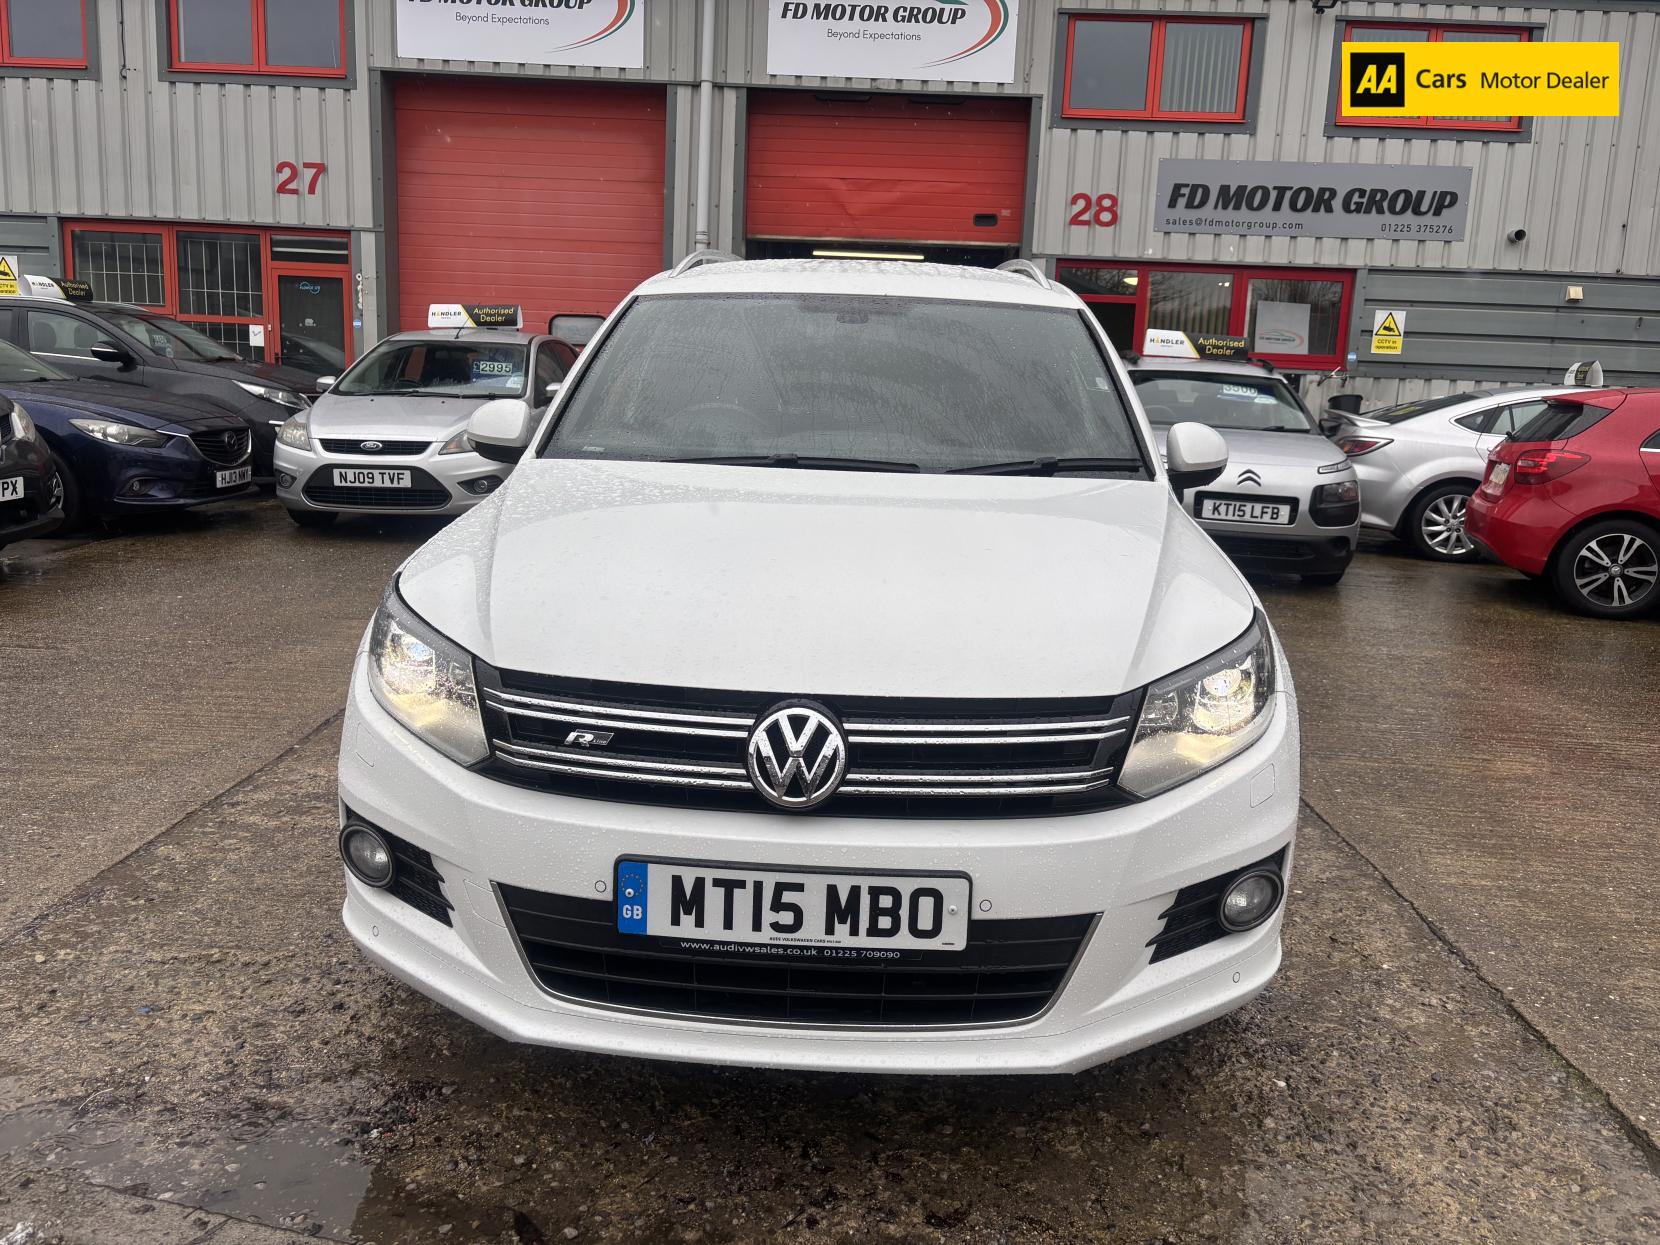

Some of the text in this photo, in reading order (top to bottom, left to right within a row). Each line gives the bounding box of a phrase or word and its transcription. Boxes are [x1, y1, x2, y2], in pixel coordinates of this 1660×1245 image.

[455, 12, 550, 26] Beyond Expectations
[781, 2, 966, 25] FD MOTOR GROUP
[827, 28, 922, 42] Beyond Expectations
[275, 161, 326, 195] 27
[1167, 183, 1459, 217] FD MOTOR GROUP
[1069, 192, 1119, 228] 28
[1165, 217, 1303, 231] sales@fdmotorgroup.com
[1380, 223, 1454, 235] 01225 375276
[473, 307, 514, 315] Authorised
[480, 314, 506, 322] Dealer
[1198, 337, 1245, 348] Authorised
[1205, 346, 1236, 356] Dealer
[339, 471, 405, 485] NJ09 TVF
[1, 480, 18, 497] PX
[1212, 502, 1280, 520] KT15 LFB
[622, 904, 642, 920] GB
[670, 873, 944, 940] MT15 MBO
[680, 940, 817, 957] www.audivwsales.co.uk
[823, 948, 857, 958] 01225
[860, 950, 901, 959] 709090
